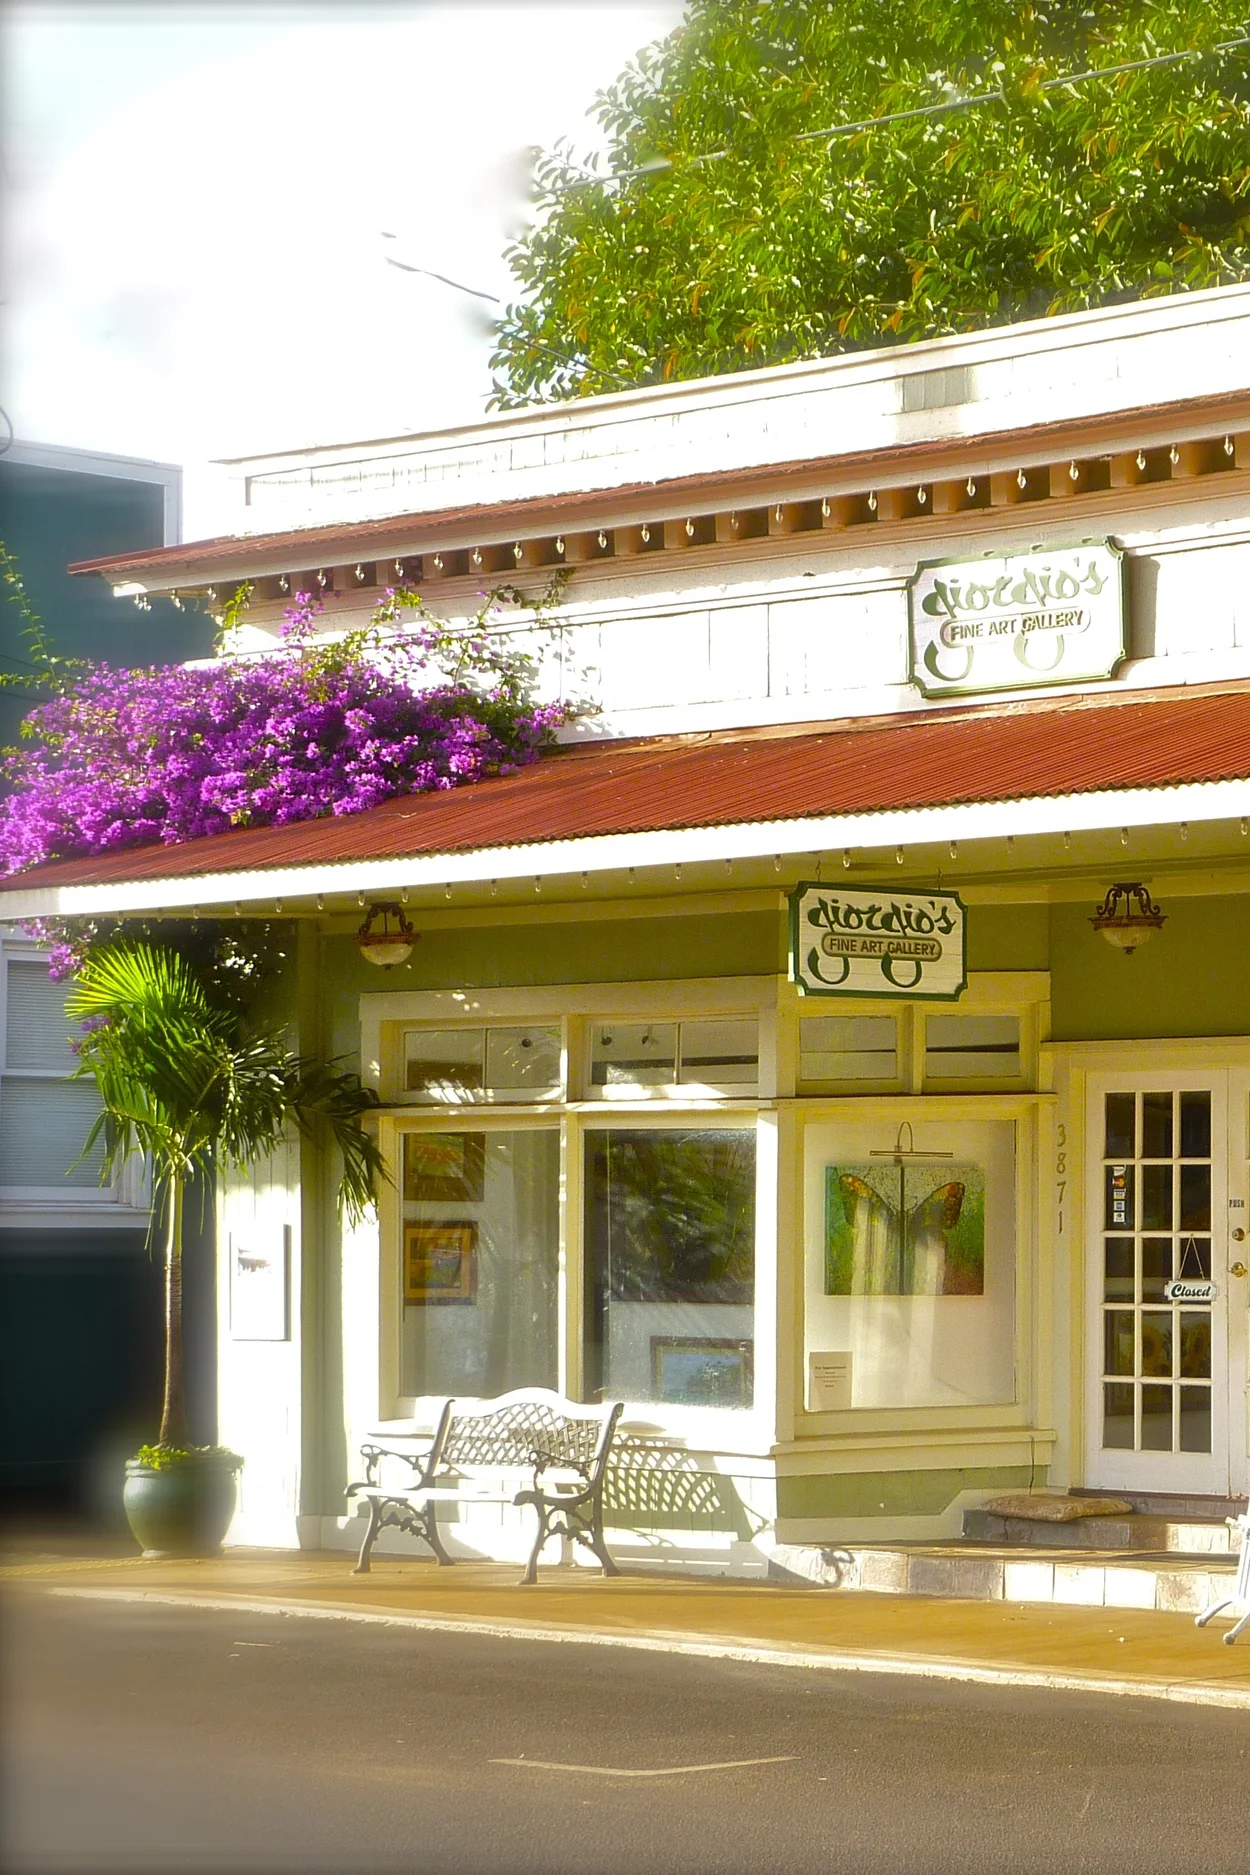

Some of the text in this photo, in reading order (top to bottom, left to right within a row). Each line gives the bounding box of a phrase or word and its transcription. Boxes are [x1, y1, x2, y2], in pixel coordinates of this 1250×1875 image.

[951, 610, 1084, 642] FINE ART GALLERY
[830, 938, 936, 956] FINE ART GALLERY
[1056, 1123, 1067, 1234] 3871
[1229, 1199, 1245, 1208] PUSH
[1171, 1284, 1212, 1298] Closed
